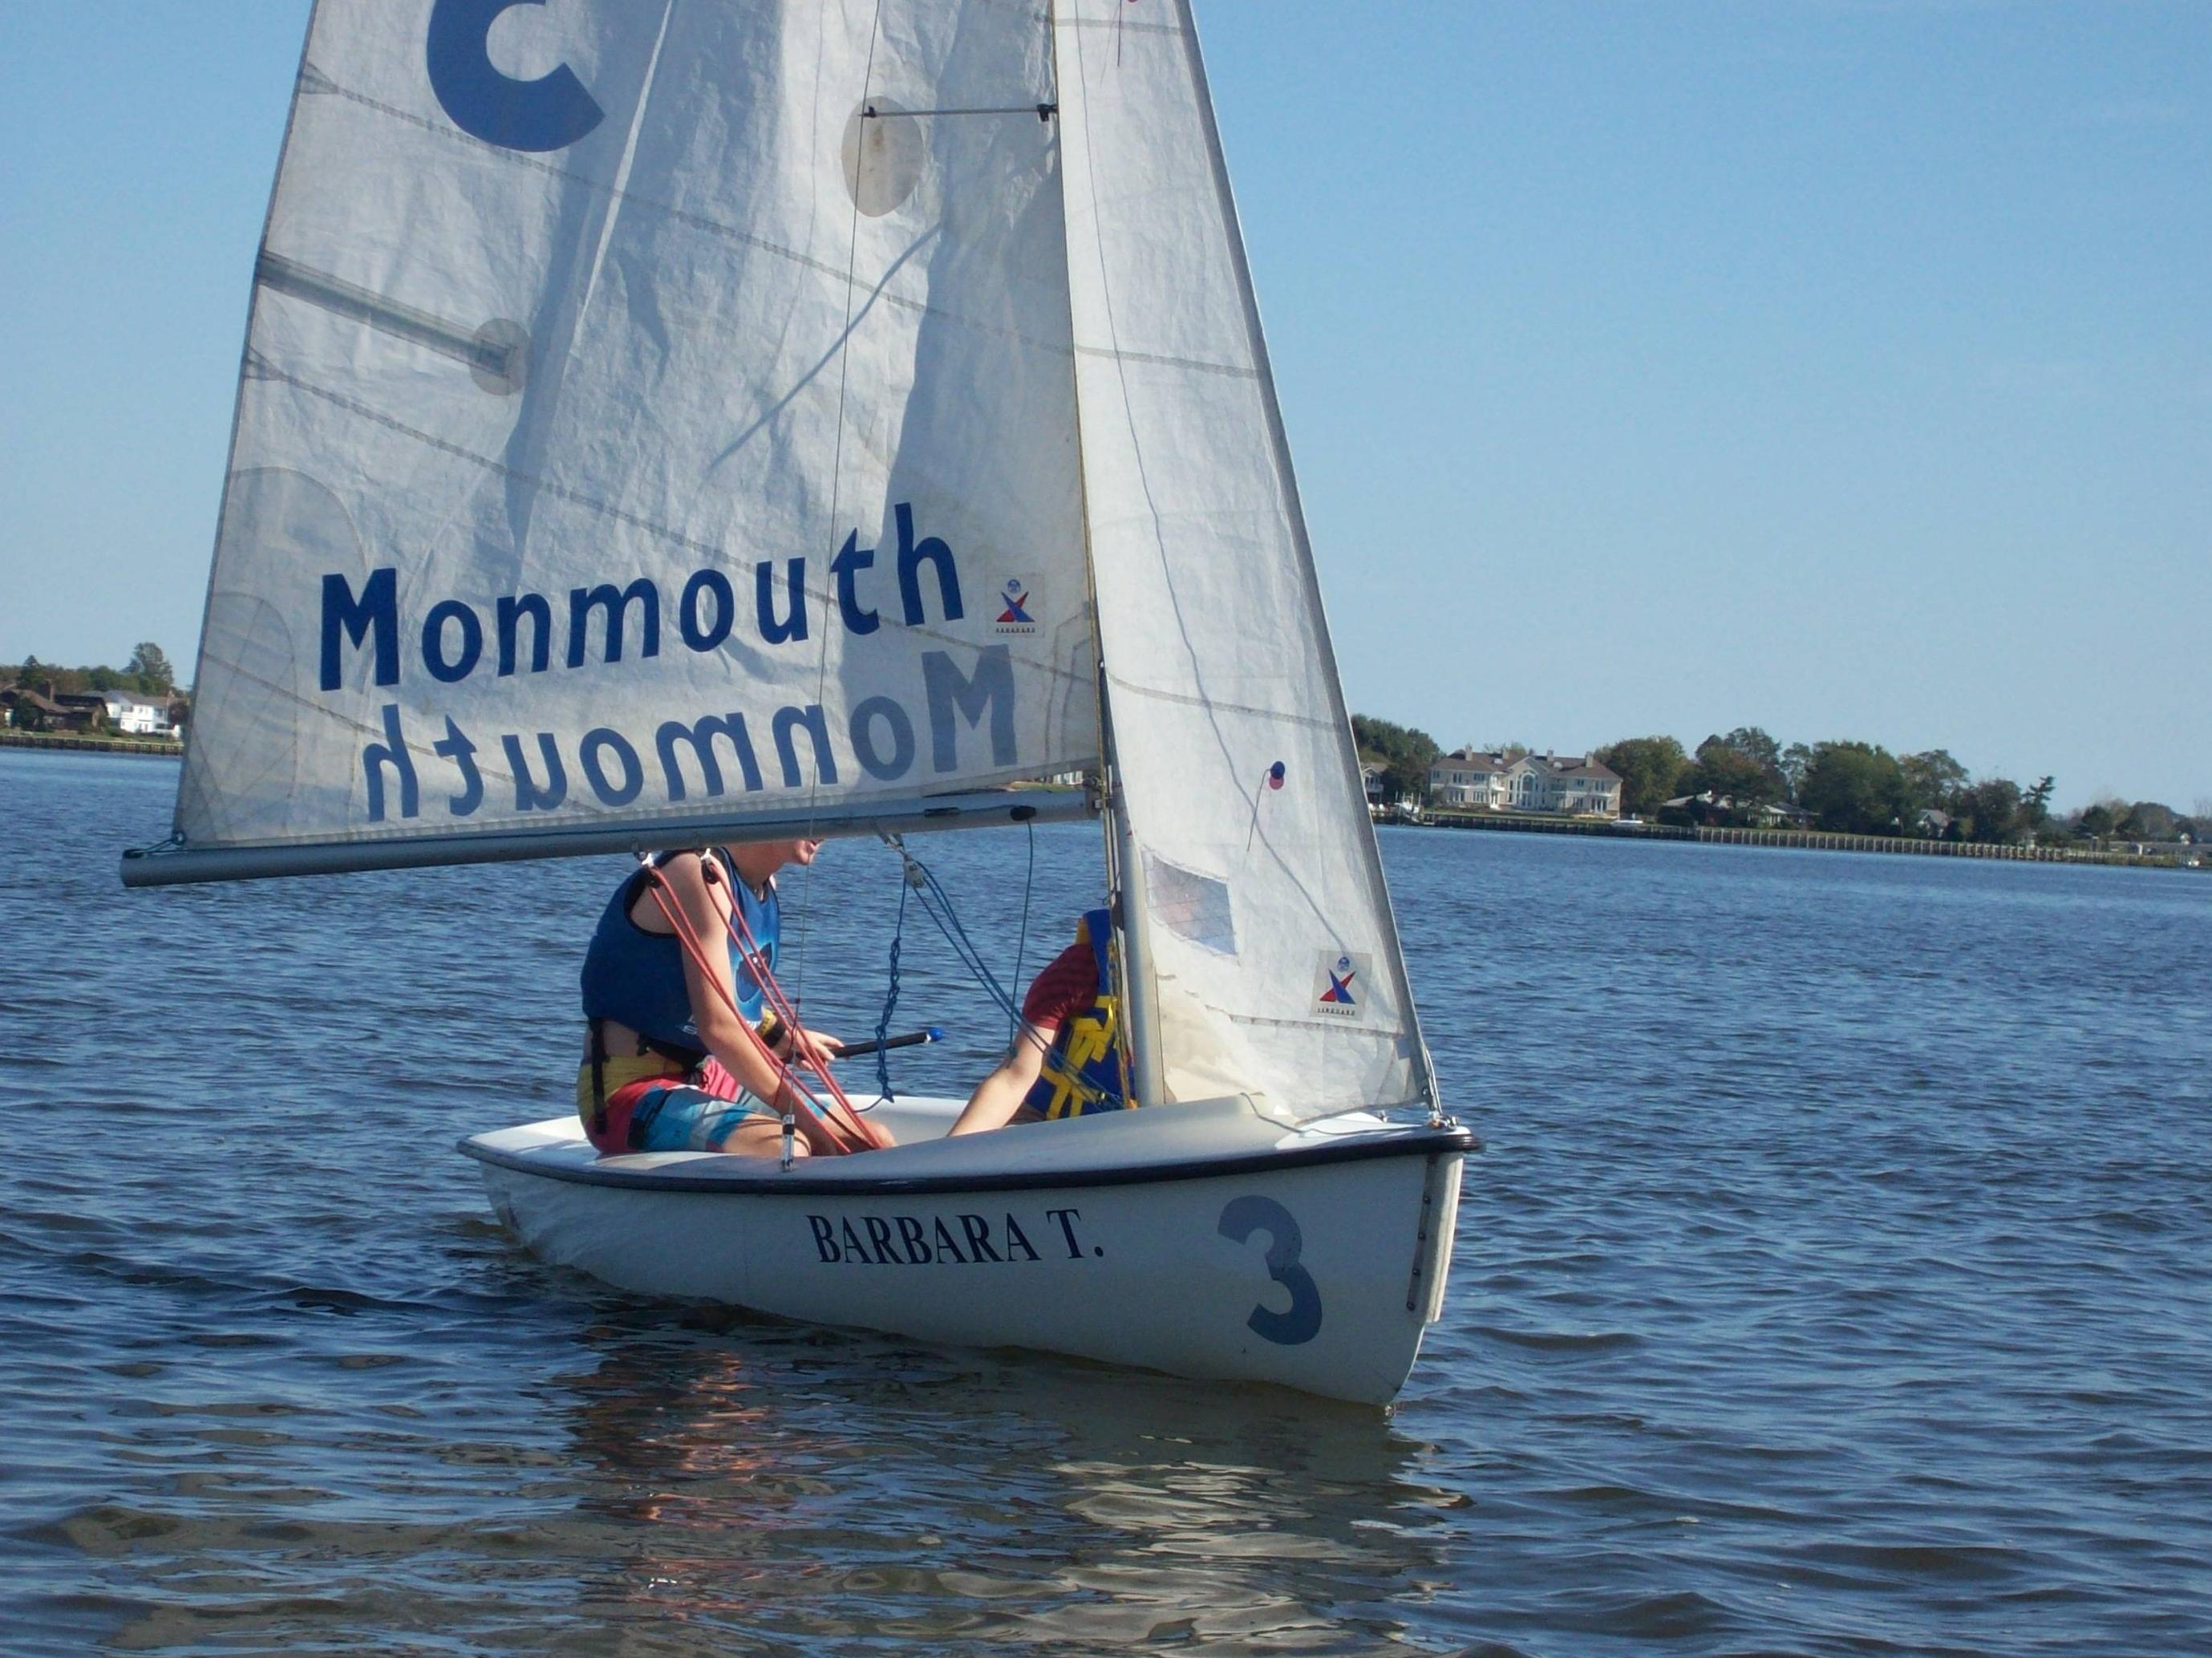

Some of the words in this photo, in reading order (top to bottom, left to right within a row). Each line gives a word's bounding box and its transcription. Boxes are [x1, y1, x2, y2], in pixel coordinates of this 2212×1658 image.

[320, 501, 965, 691] Monmouth
[806, 1214, 1041, 1265] BARBARA
[1045, 1209, 1105, 1260] T.
[1217, 1194, 1323, 1346] 3
